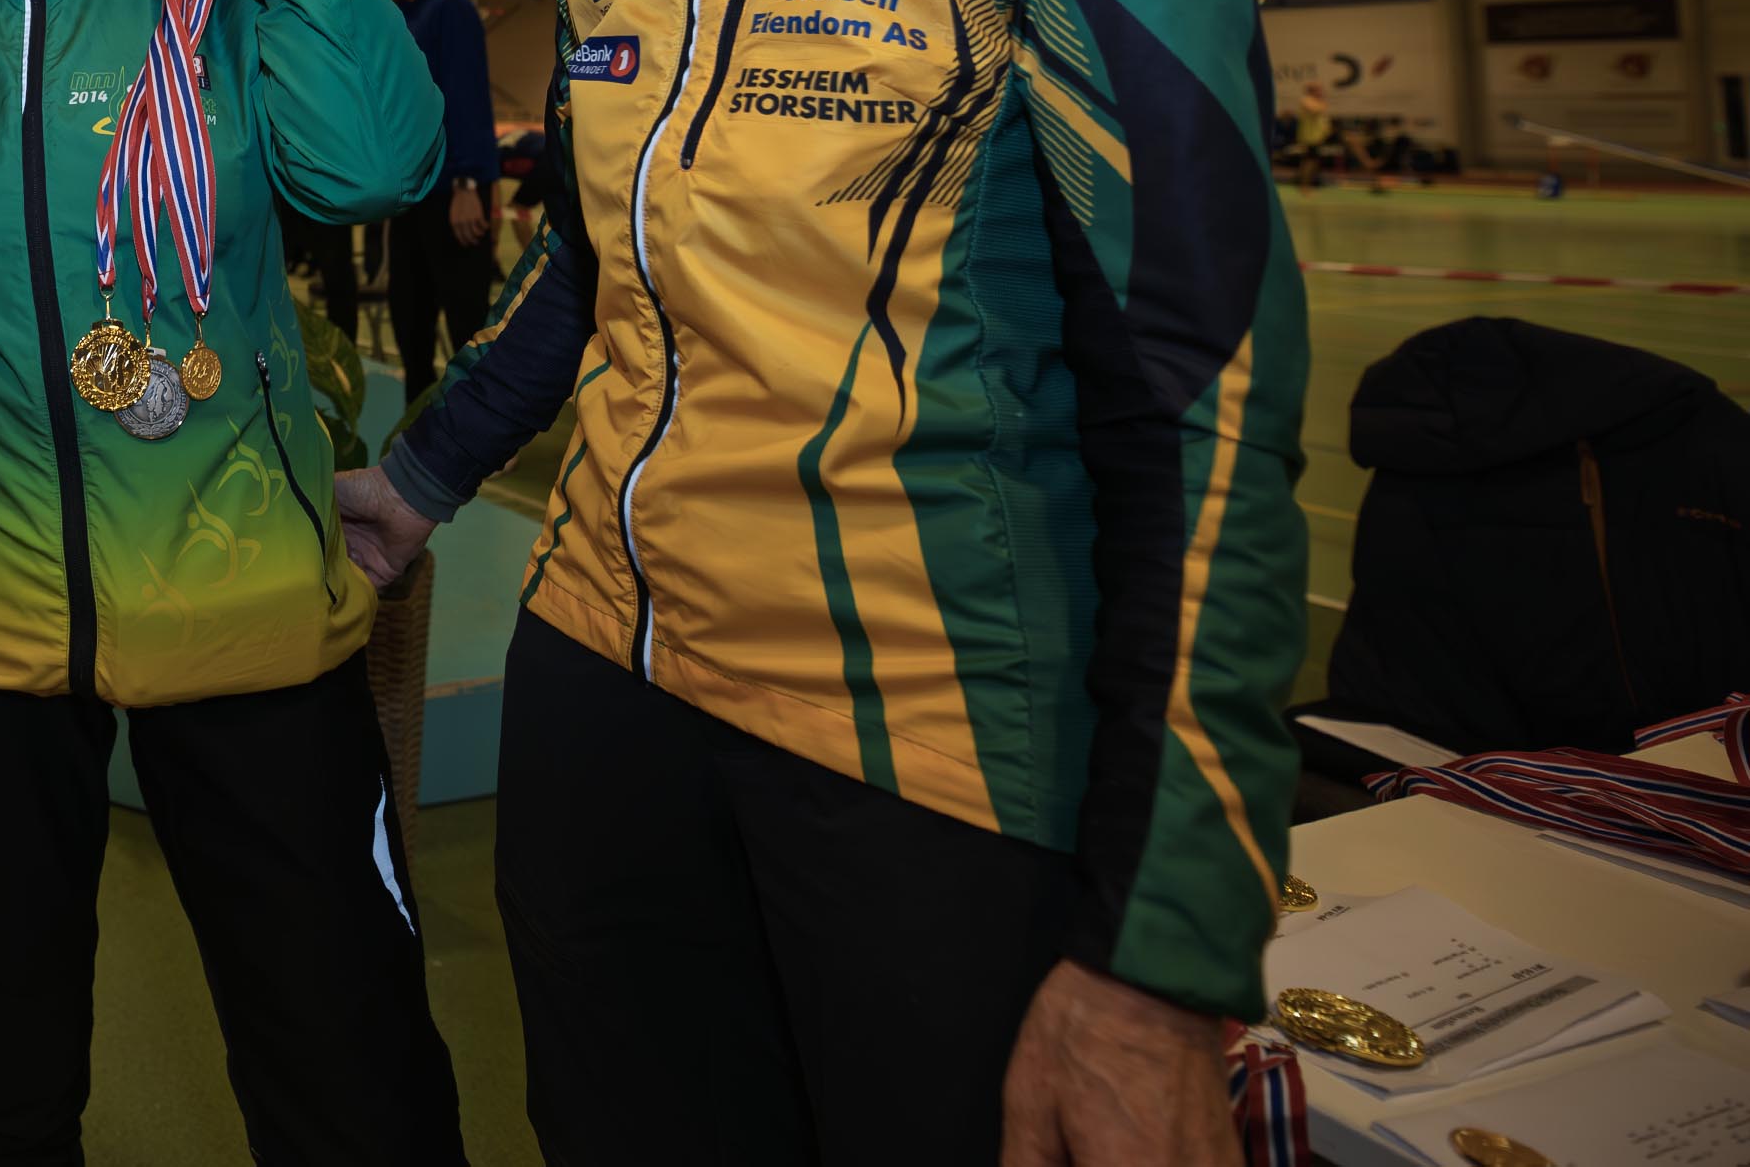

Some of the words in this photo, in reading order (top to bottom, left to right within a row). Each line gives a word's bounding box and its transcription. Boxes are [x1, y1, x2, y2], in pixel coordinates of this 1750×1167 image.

[751, 11, 872, 39] Eiendom
[883, 21, 929, 52] As
[734, 68, 871, 96] JESSHEIM
[68, 90, 108, 105] 2014
[728, 92, 918, 125] STORSENTER
